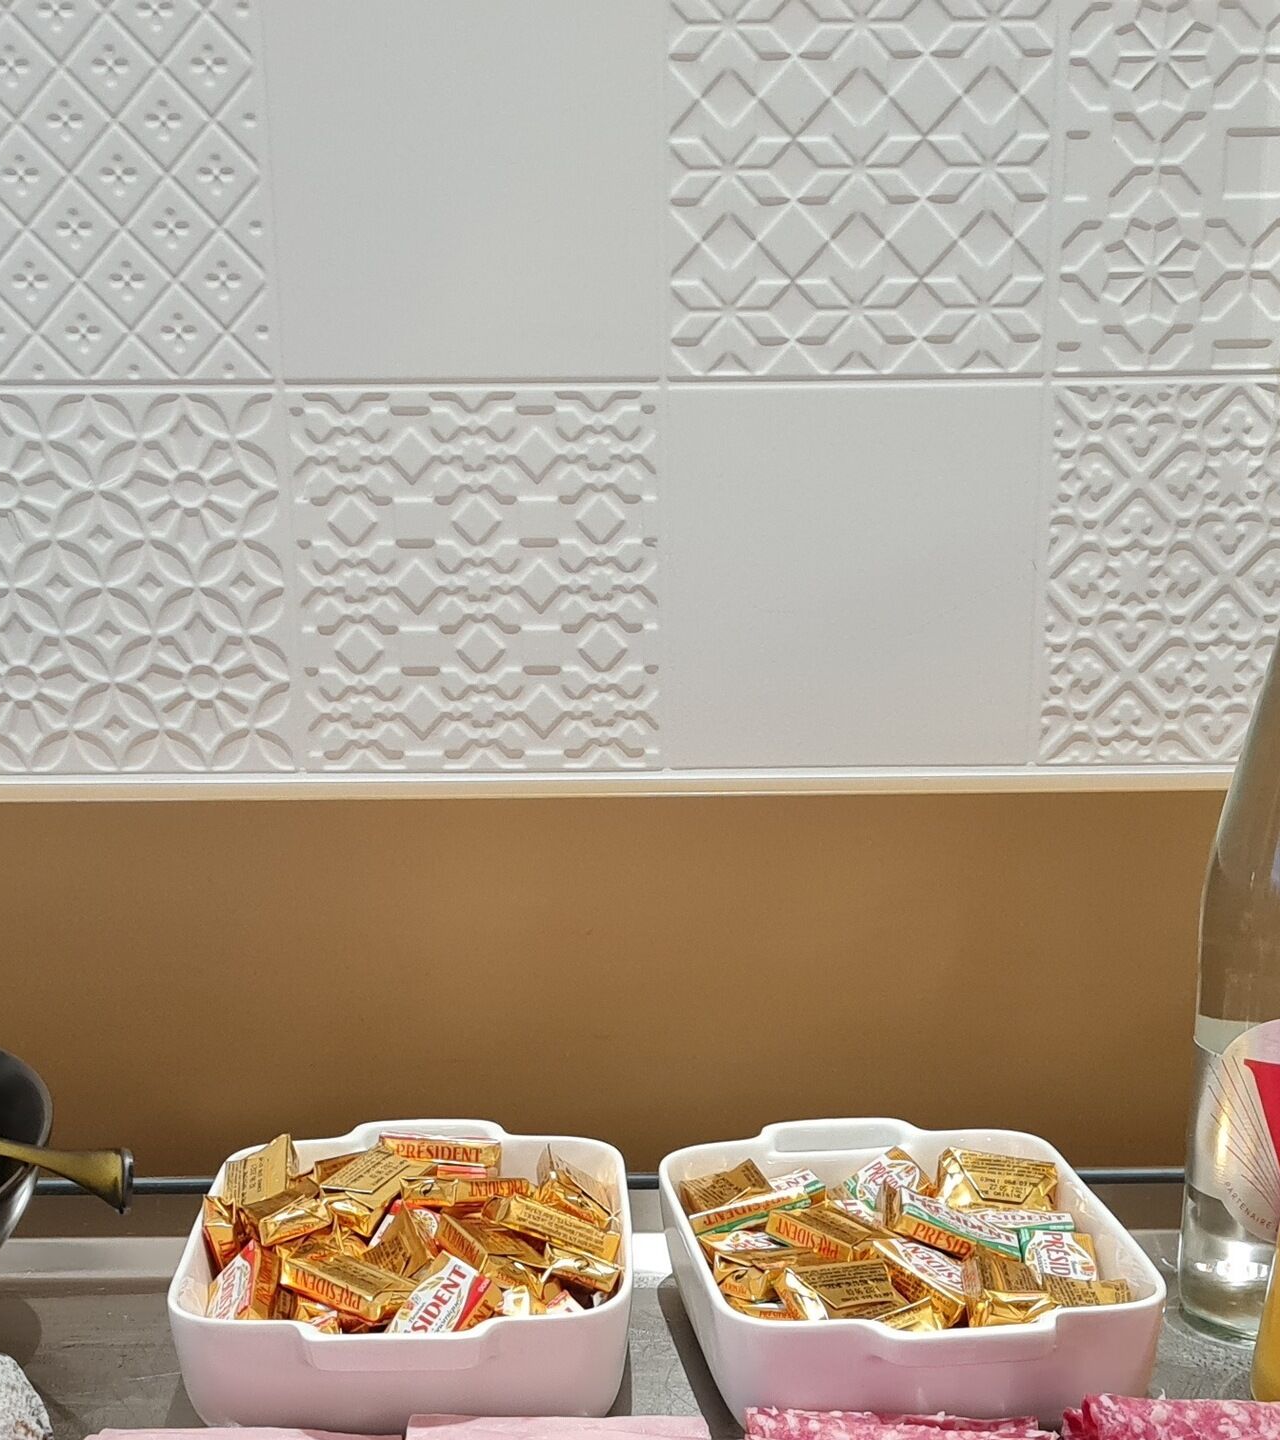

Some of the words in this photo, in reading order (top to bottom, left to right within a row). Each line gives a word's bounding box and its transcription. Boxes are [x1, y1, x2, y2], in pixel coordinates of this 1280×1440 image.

[396, 1142, 483, 1163] PRÉSIDENT
[1042, 1231, 1071, 1277] PRÉSID
[411, 1265, 467, 1333] SIDENT
